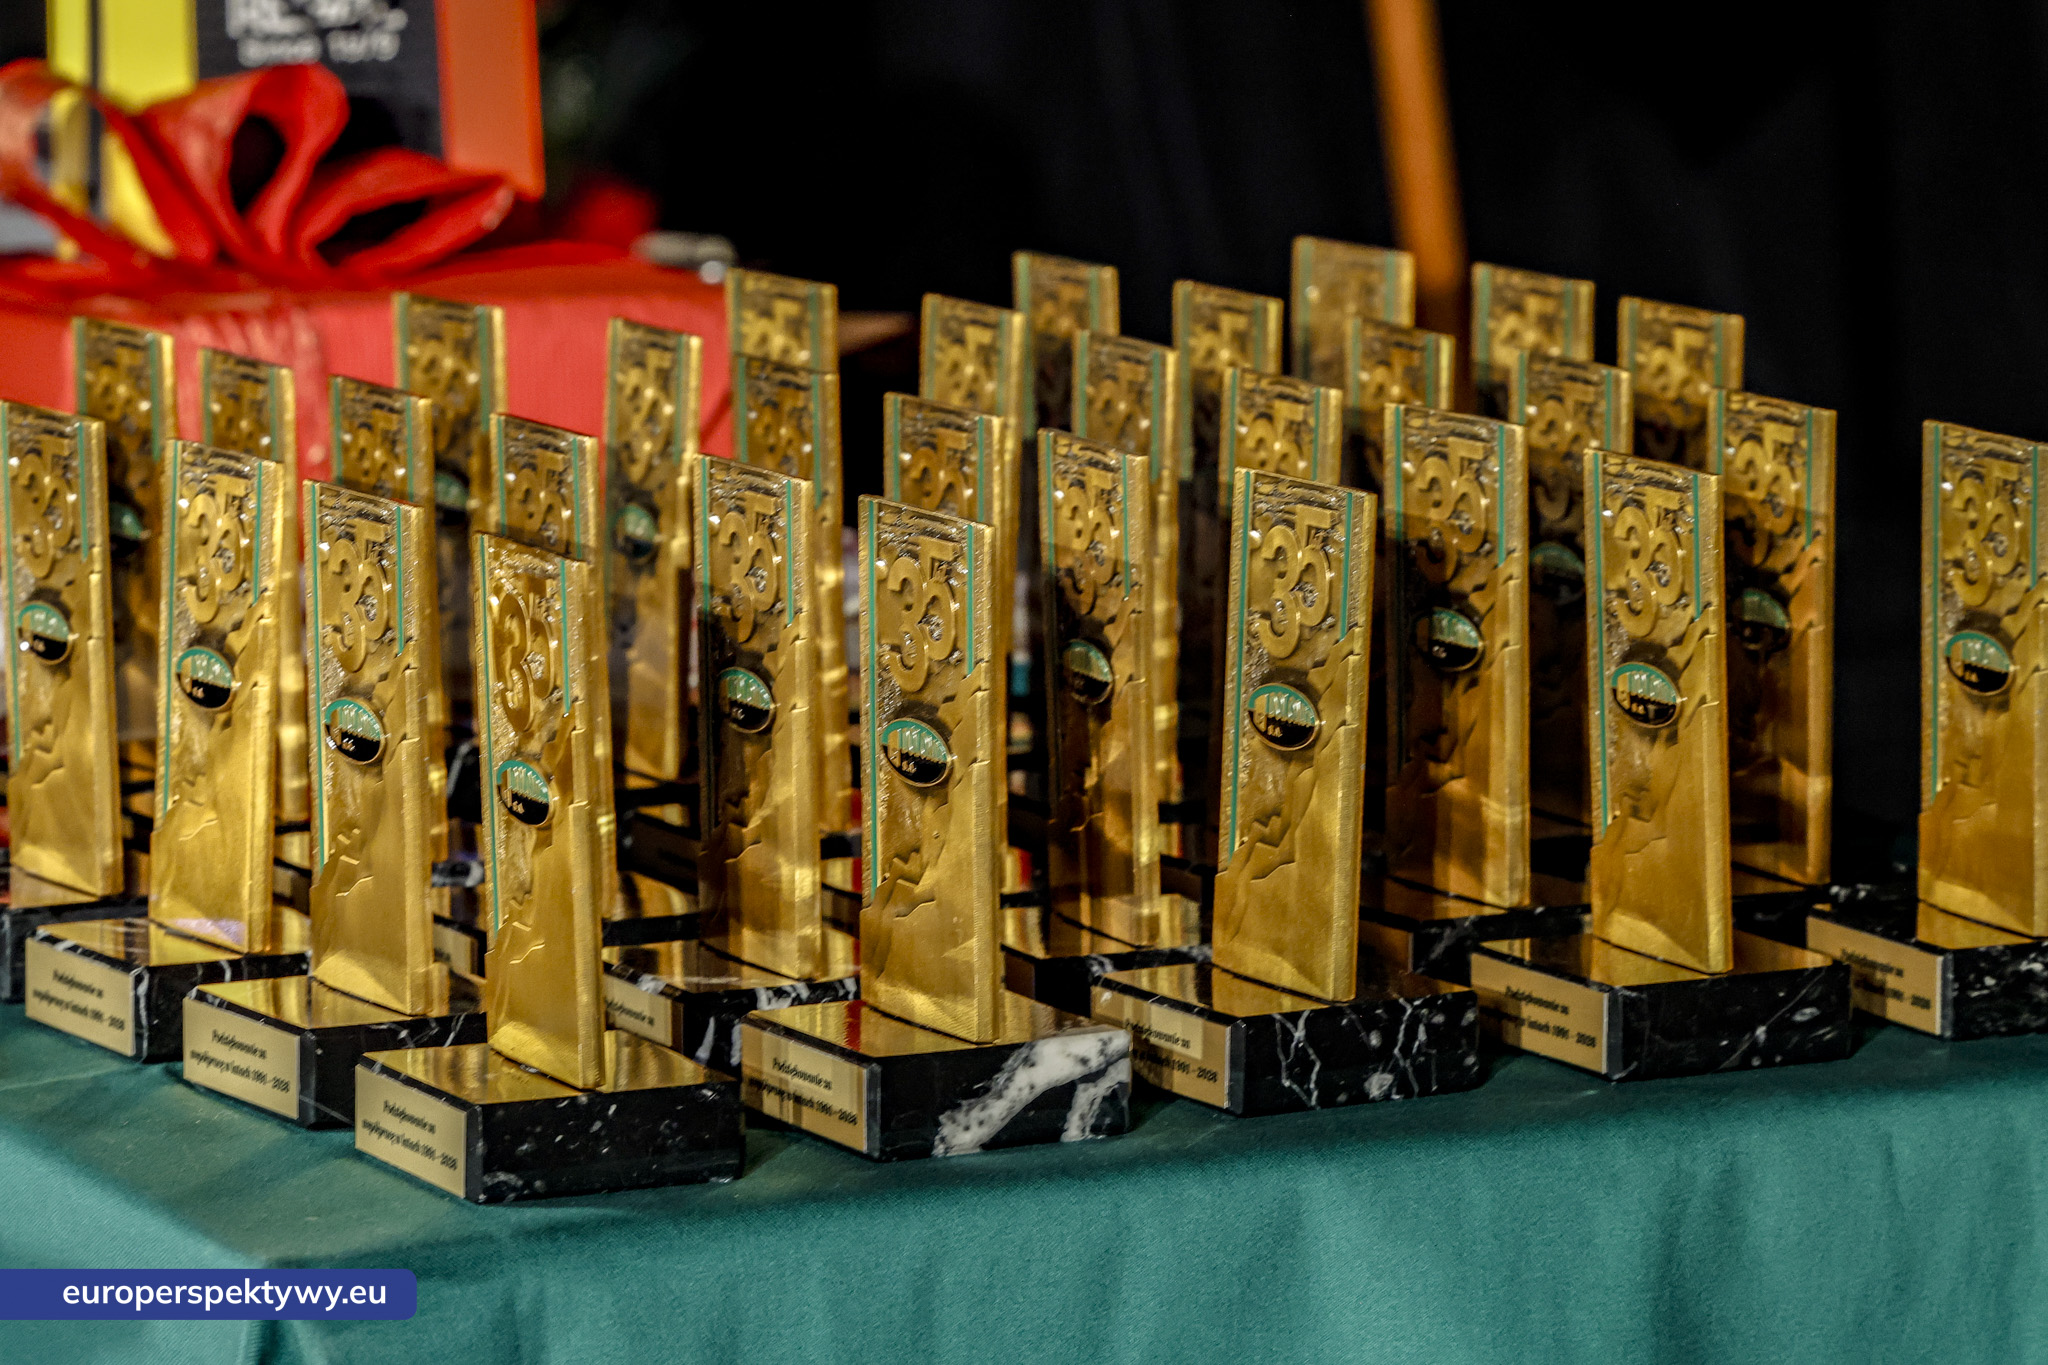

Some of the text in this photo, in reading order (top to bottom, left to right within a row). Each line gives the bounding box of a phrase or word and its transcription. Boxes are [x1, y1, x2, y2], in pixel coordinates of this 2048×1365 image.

[887, 535, 960, 692] 35
[1257, 503, 1333, 659] 35
[1613, 485, 1682, 637] 35
